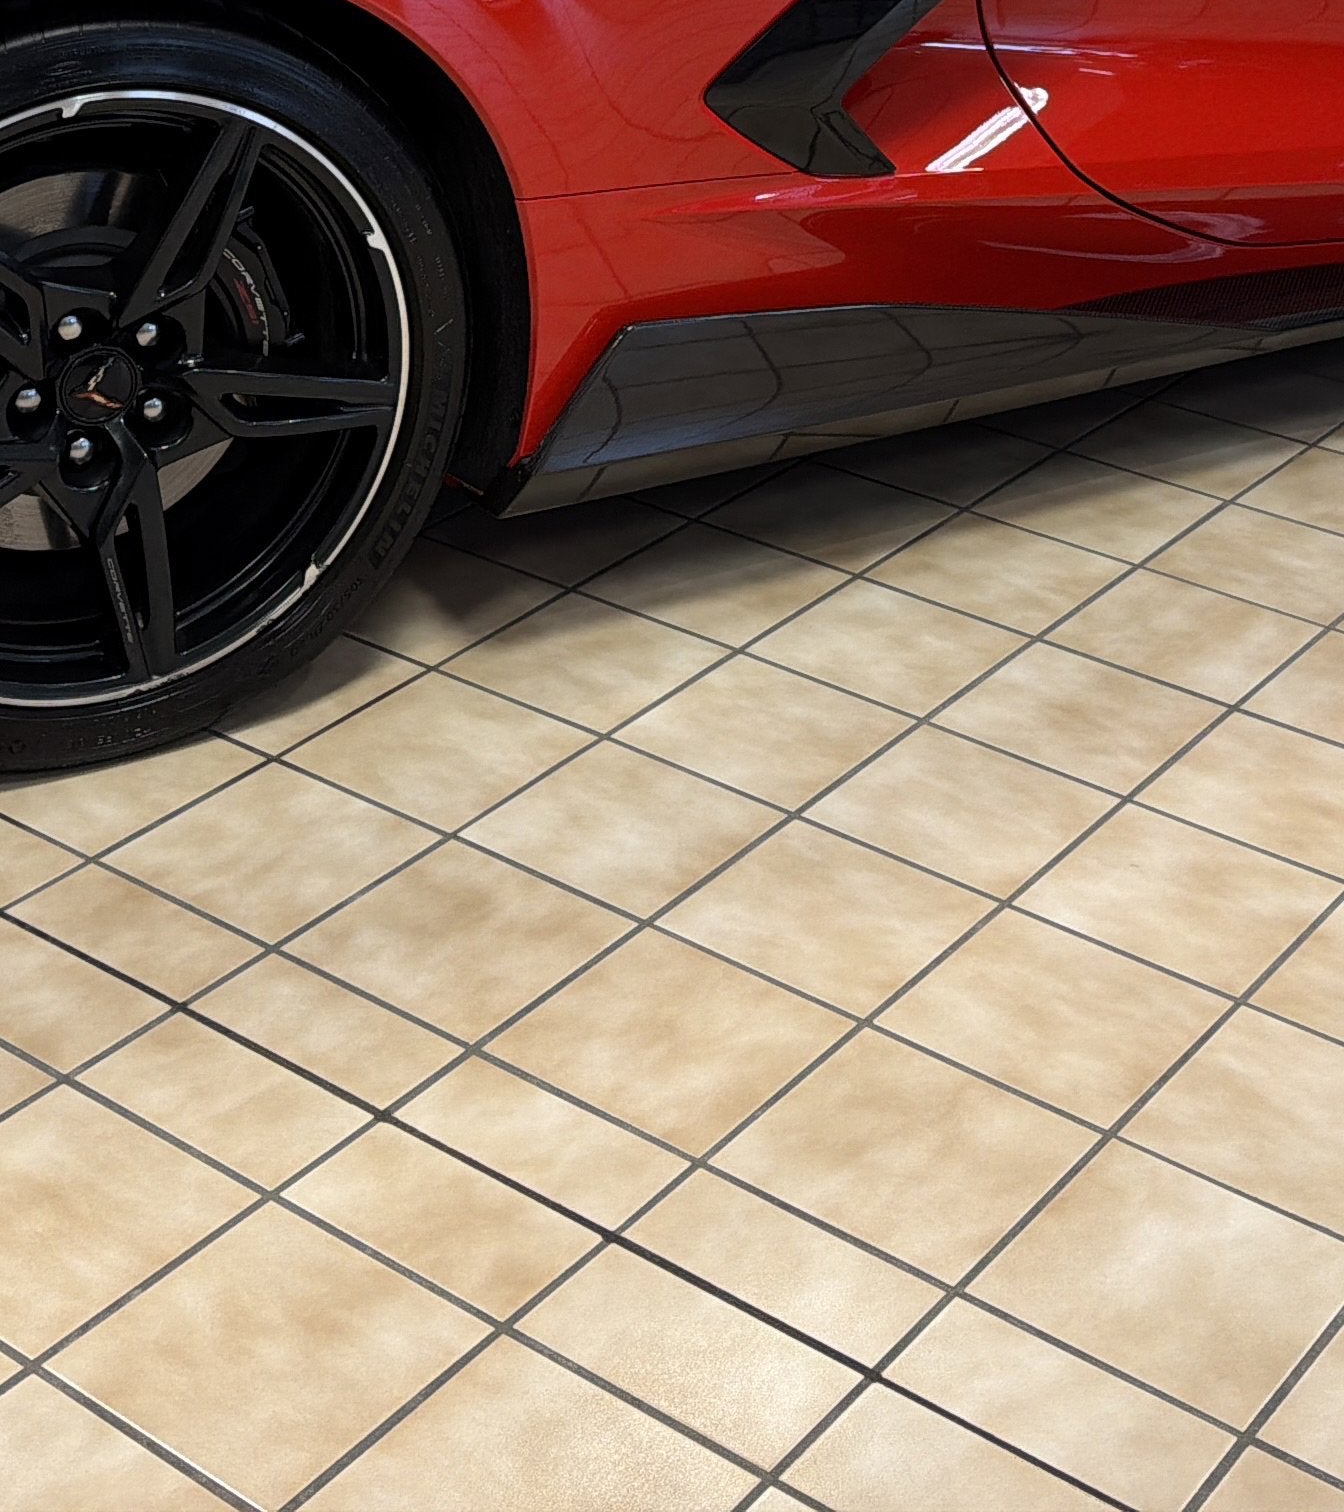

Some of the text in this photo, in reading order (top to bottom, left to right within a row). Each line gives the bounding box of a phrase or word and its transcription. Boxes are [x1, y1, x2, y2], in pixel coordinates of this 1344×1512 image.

[223, 248, 269, 357] CORVETTE
[375, 390, 450, 558] MICHELIN
[106, 557, 134, 644] CORVETTE
